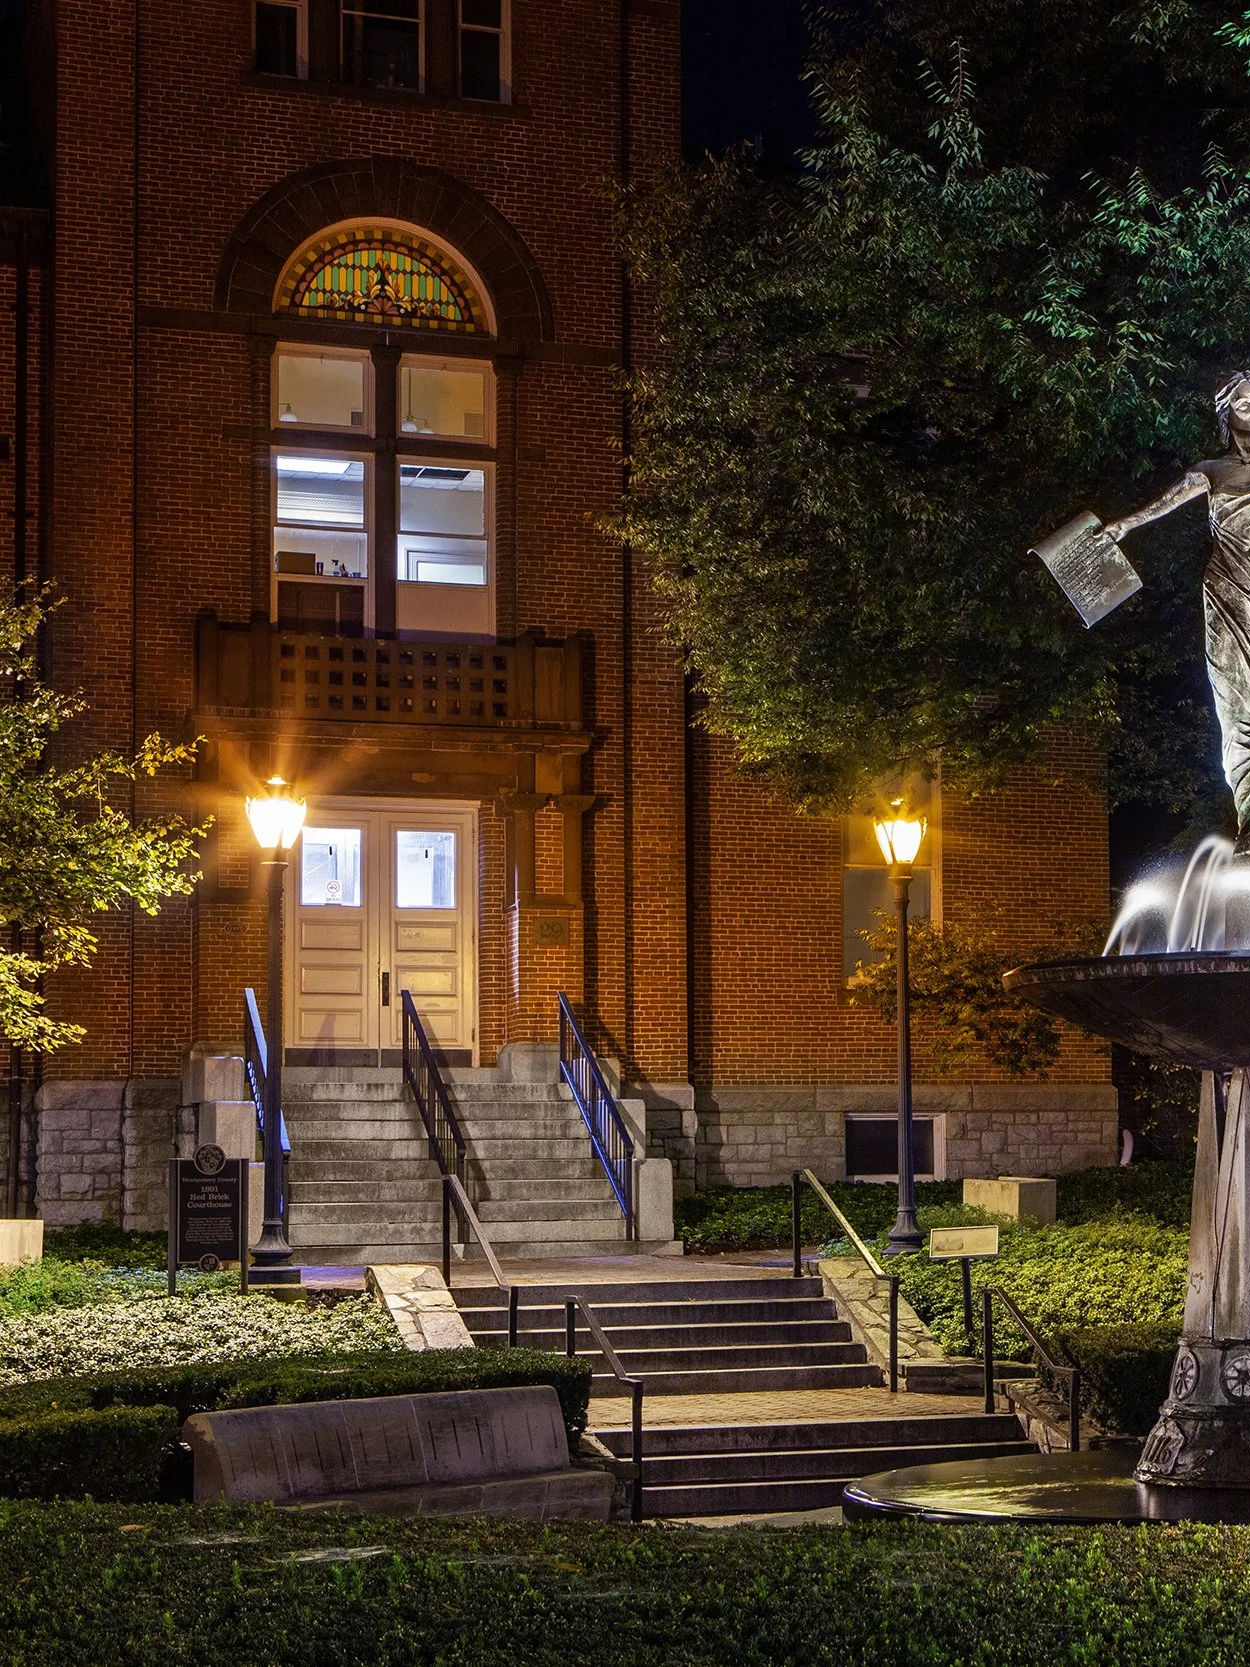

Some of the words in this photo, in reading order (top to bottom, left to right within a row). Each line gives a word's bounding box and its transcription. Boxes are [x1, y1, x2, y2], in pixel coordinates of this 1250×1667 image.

[539, 922, 564, 939] 29
[200, 1185, 219, 1193] 1891
[190, 1193, 206, 1201] Red
[208, 1193, 230, 1201] Brick
[186, 1201, 233, 1209] Courthouse
